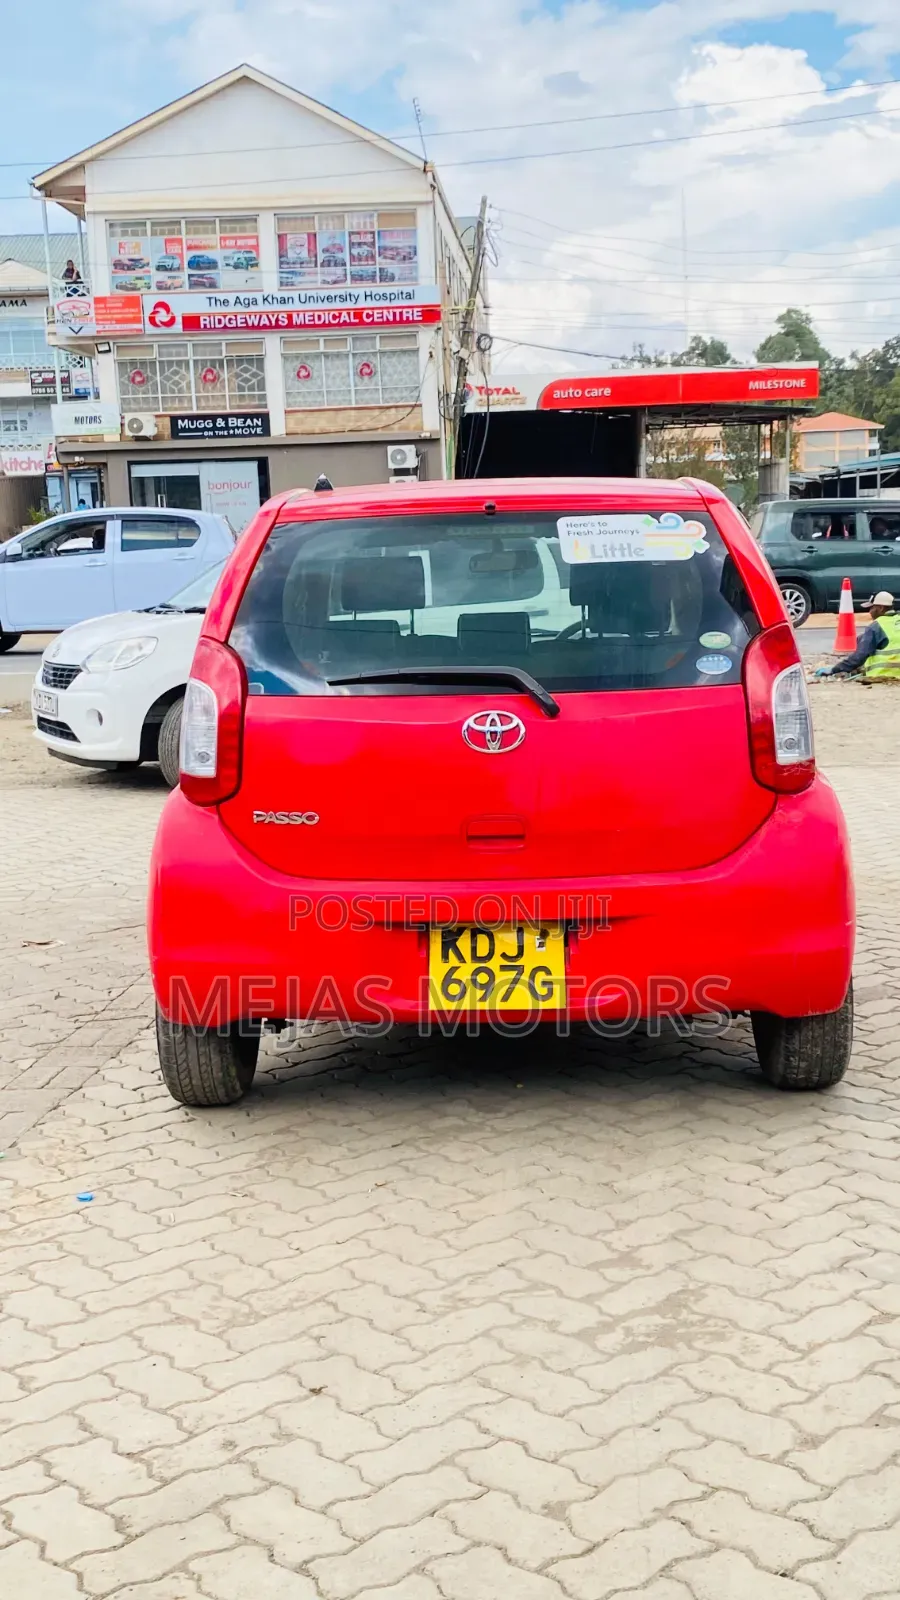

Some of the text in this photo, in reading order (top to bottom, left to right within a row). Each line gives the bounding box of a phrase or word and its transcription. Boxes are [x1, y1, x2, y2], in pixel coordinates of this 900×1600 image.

[206, 289, 415, 308] The Aga Khan University Hospital
[200, 308, 423, 329] RIDGEWAYS MEDICAL CENTRE
[475, 385, 521, 396] TOTAL
[748, 378, 807, 390] MILESTONE
[552, 386, 612, 399] auto care
[74, 415, 103, 425] MOTORS
[177, 417, 262, 429] MUGG & BEAN
[234, 427, 263, 435] MOVE
[207, 480, 252, 493] bonjour
[565, 521, 596, 529] Here's
[567, 528, 640, 537] Fresh Journeys
[590, 540, 645, 559] Little
[253, 810, 319, 825] PASSO
[441, 926, 525, 963] KDJ
[441, 965, 554, 1003] 697G
